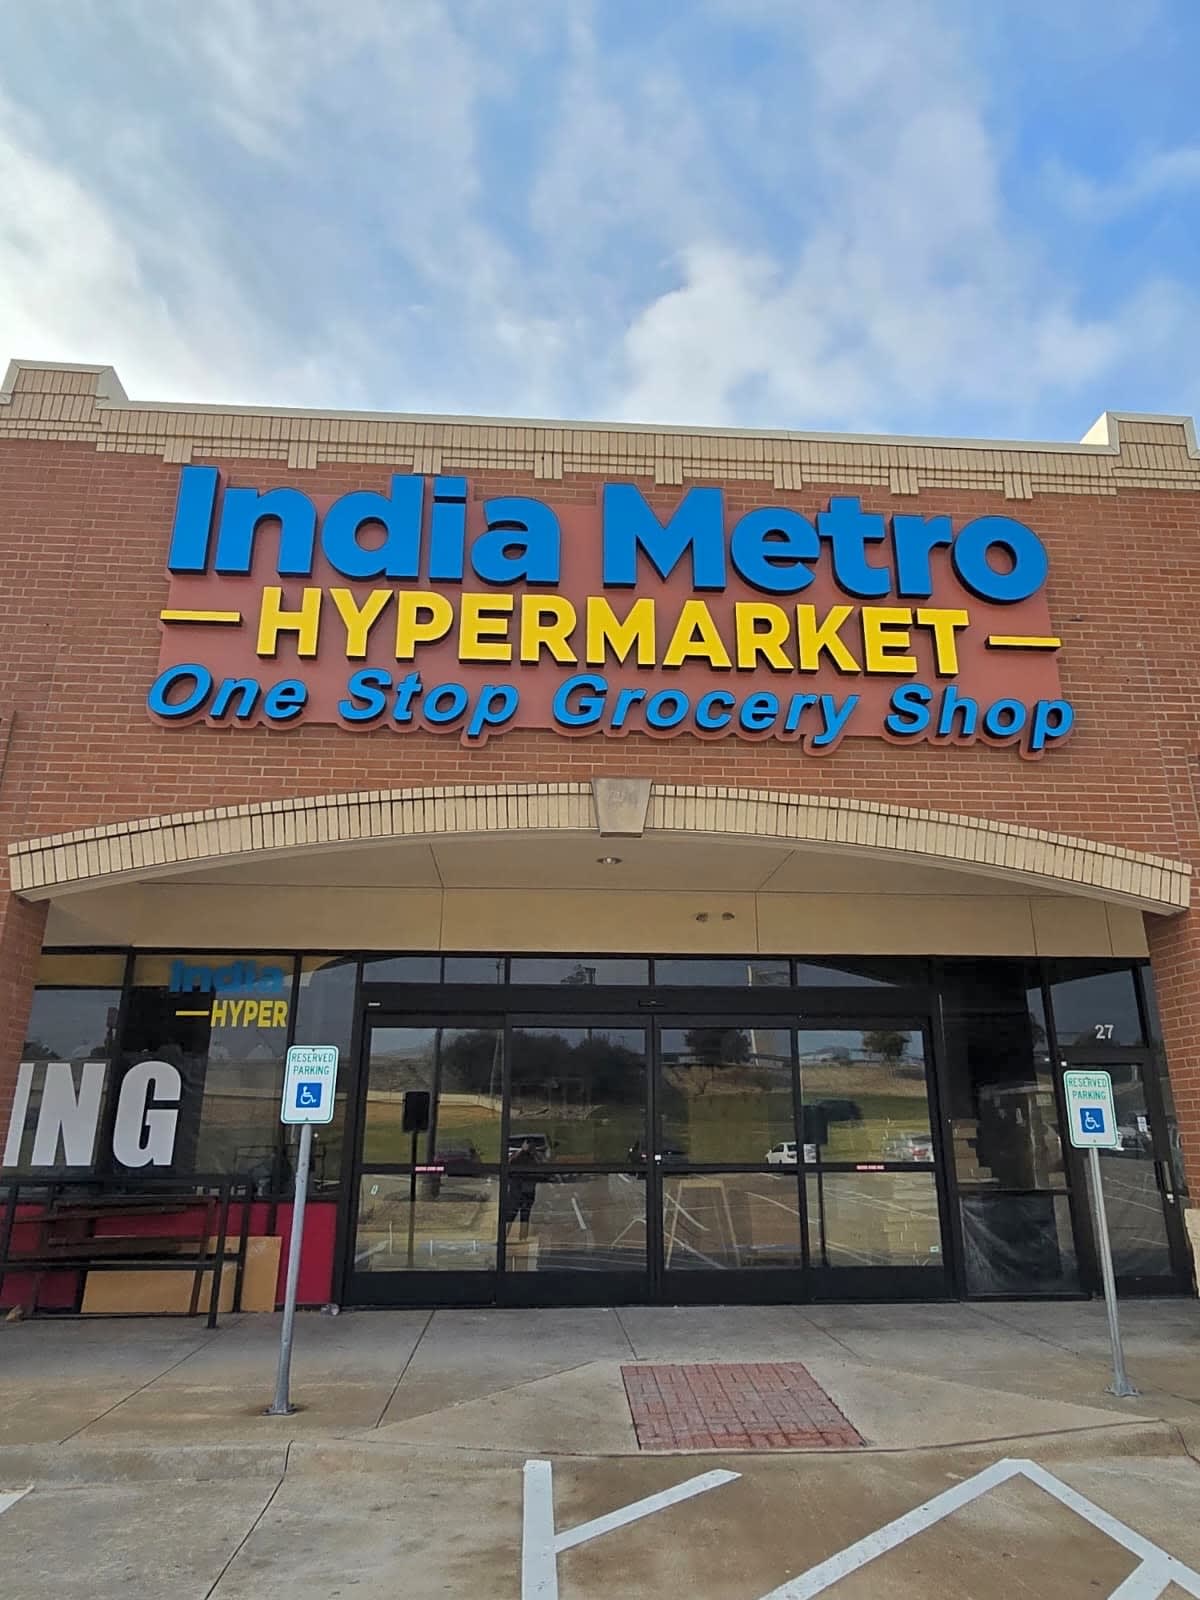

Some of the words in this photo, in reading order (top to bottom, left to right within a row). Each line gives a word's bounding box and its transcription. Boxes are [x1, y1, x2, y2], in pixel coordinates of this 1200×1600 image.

[167, 464, 562, 586] India
[602, 482, 1049, 604] Metro
[256, 586, 970, 677] HYPERMARKET
[147, 663, 308, 722] One
[338, 667, 520, 739] Stop
[551, 673, 861, 747] Grocery
[884, 681, 1076, 753] Shop
[169, 960, 284, 993] India
[210, 999, 289, 1028] HYPER
[1095, 1024, 1114, 1039] 27
[291, 1053, 335, 1063] RESERVED
[293, 1065, 331, 1075] PARKING
[1068, 1077, 1107, 1088] RESERVED
[1072, 1090, 1106, 1100] PARKING
